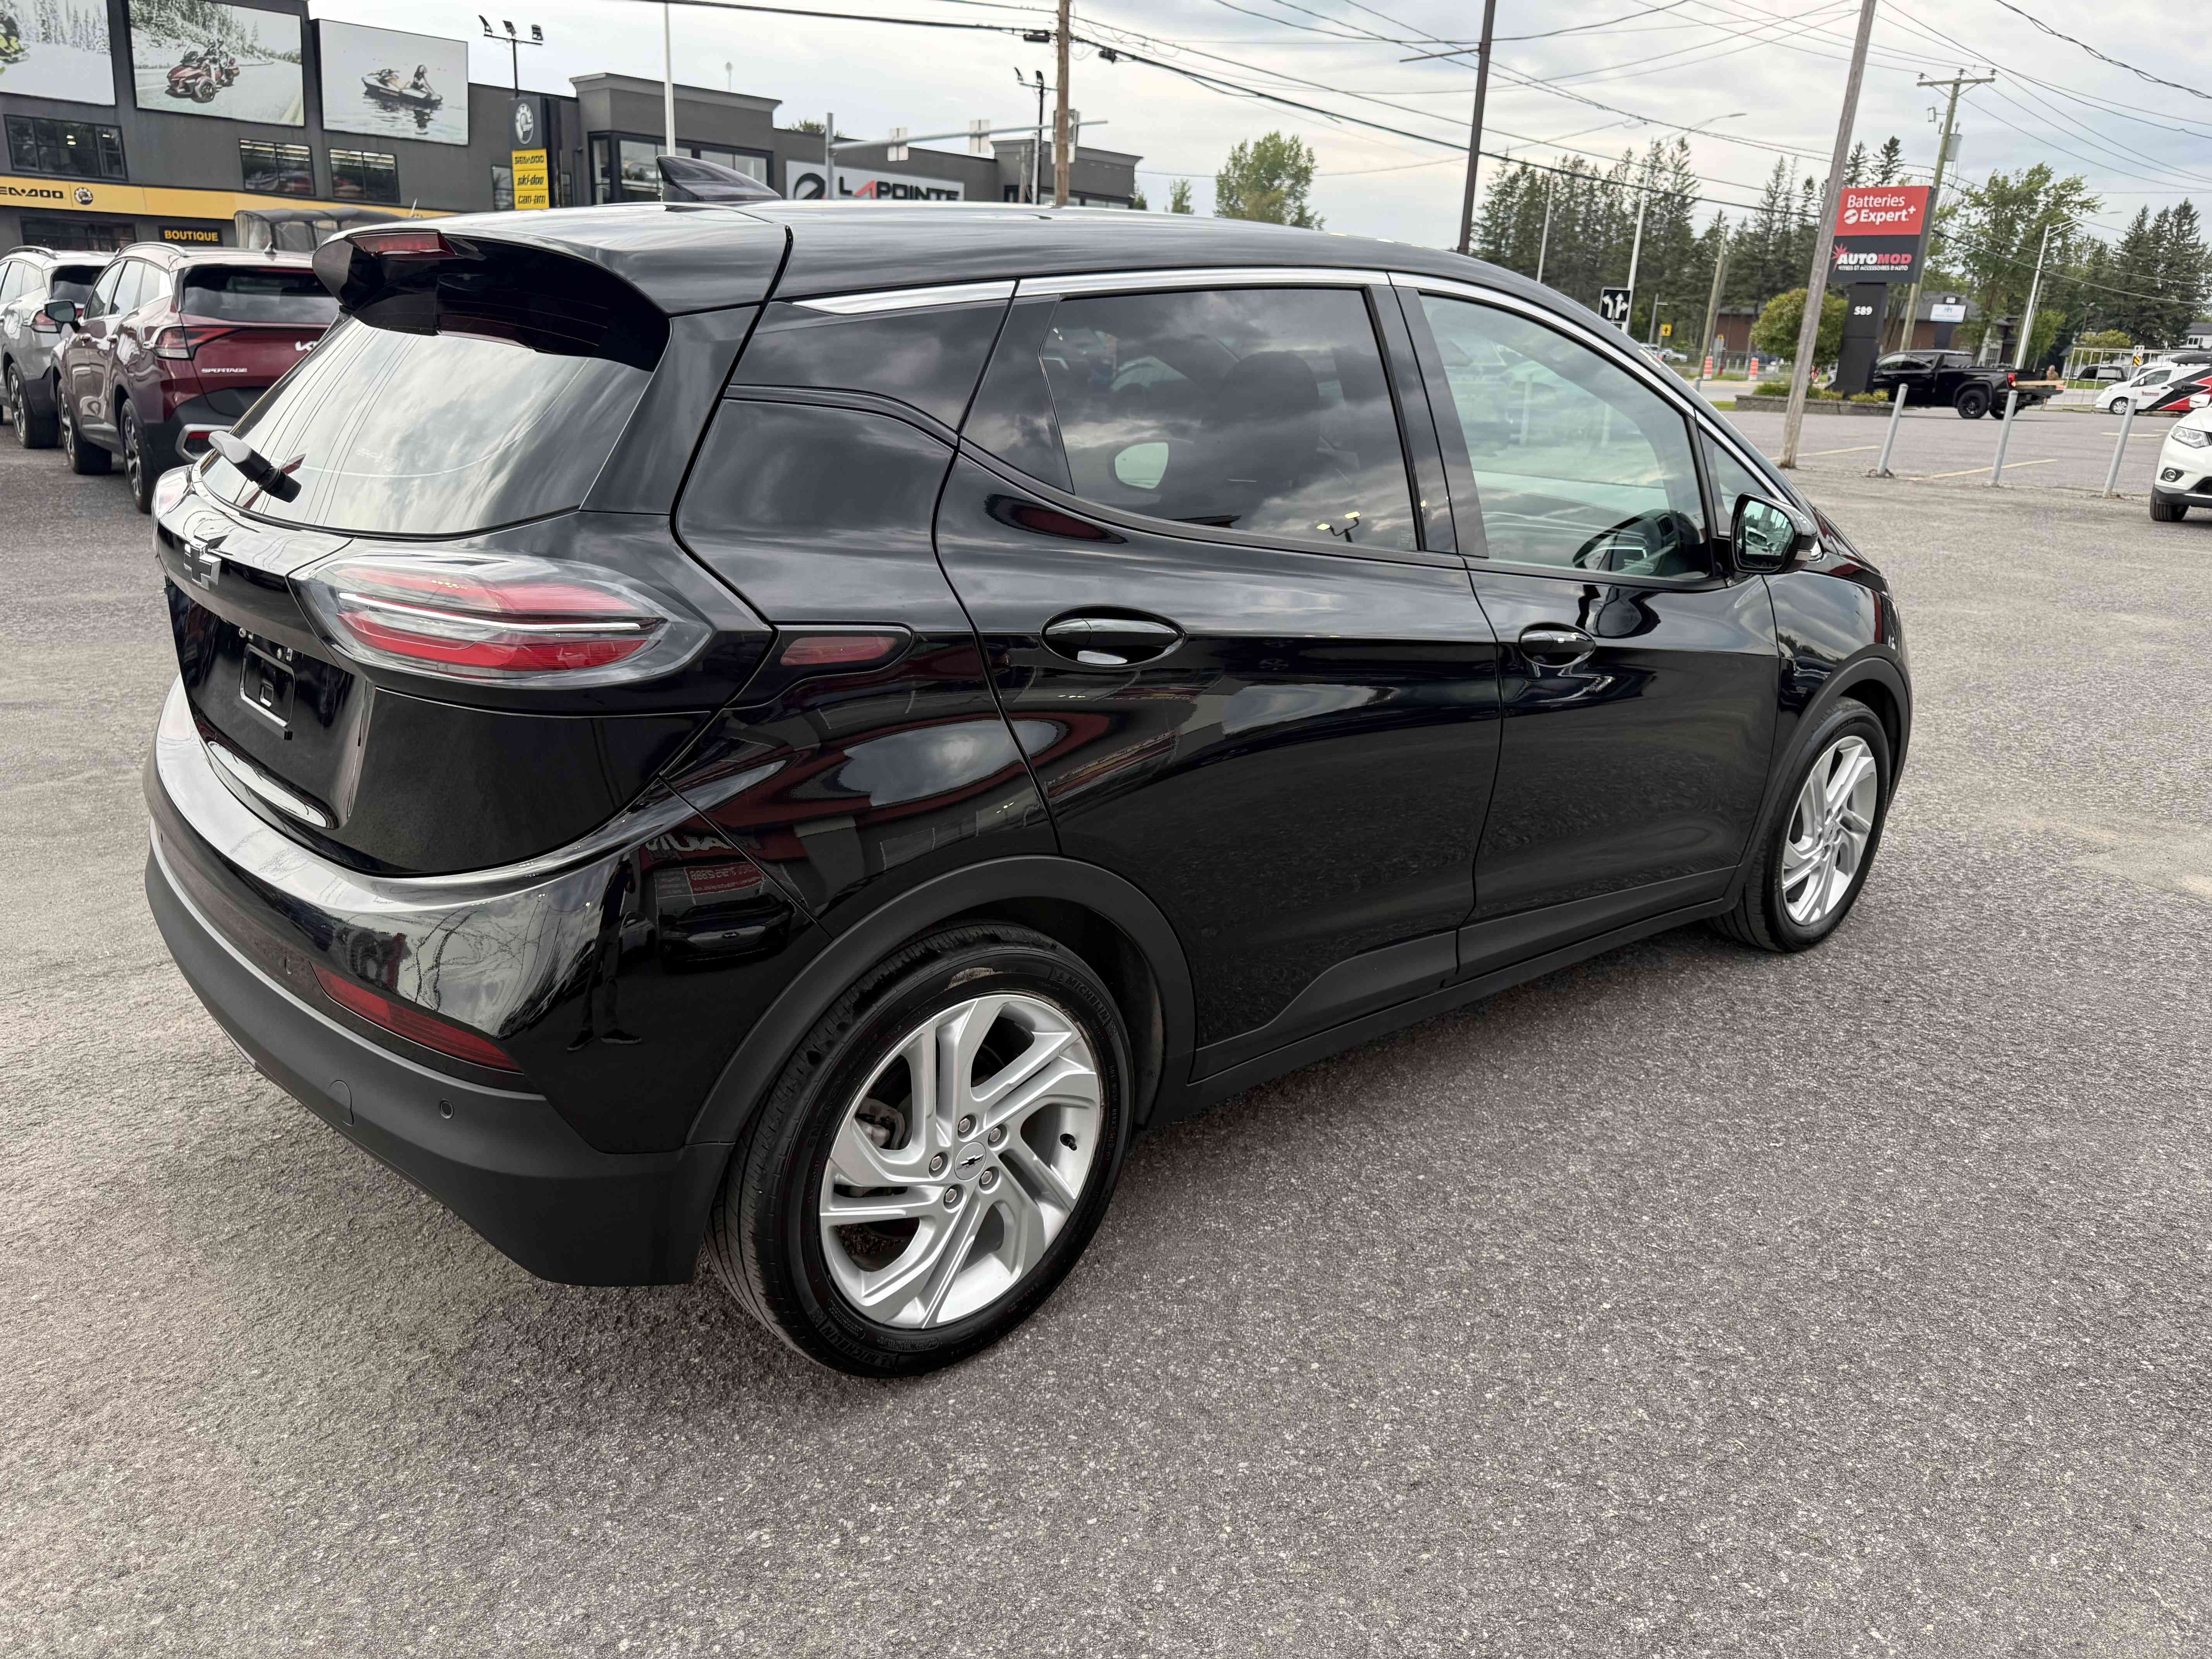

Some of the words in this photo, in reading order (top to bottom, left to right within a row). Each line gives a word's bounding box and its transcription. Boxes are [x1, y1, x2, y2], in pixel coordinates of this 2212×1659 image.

[0, 186, 63, 199] EA-DOO
[1847, 194, 1906, 208] Batteries
[164, 230, 219, 242] BOUTIQUE
[1837, 253, 1912, 264] AUTOMOD
[1853, 306, 1873, 315] 589
[1066, 975, 1110, 1022] MICHELIN
